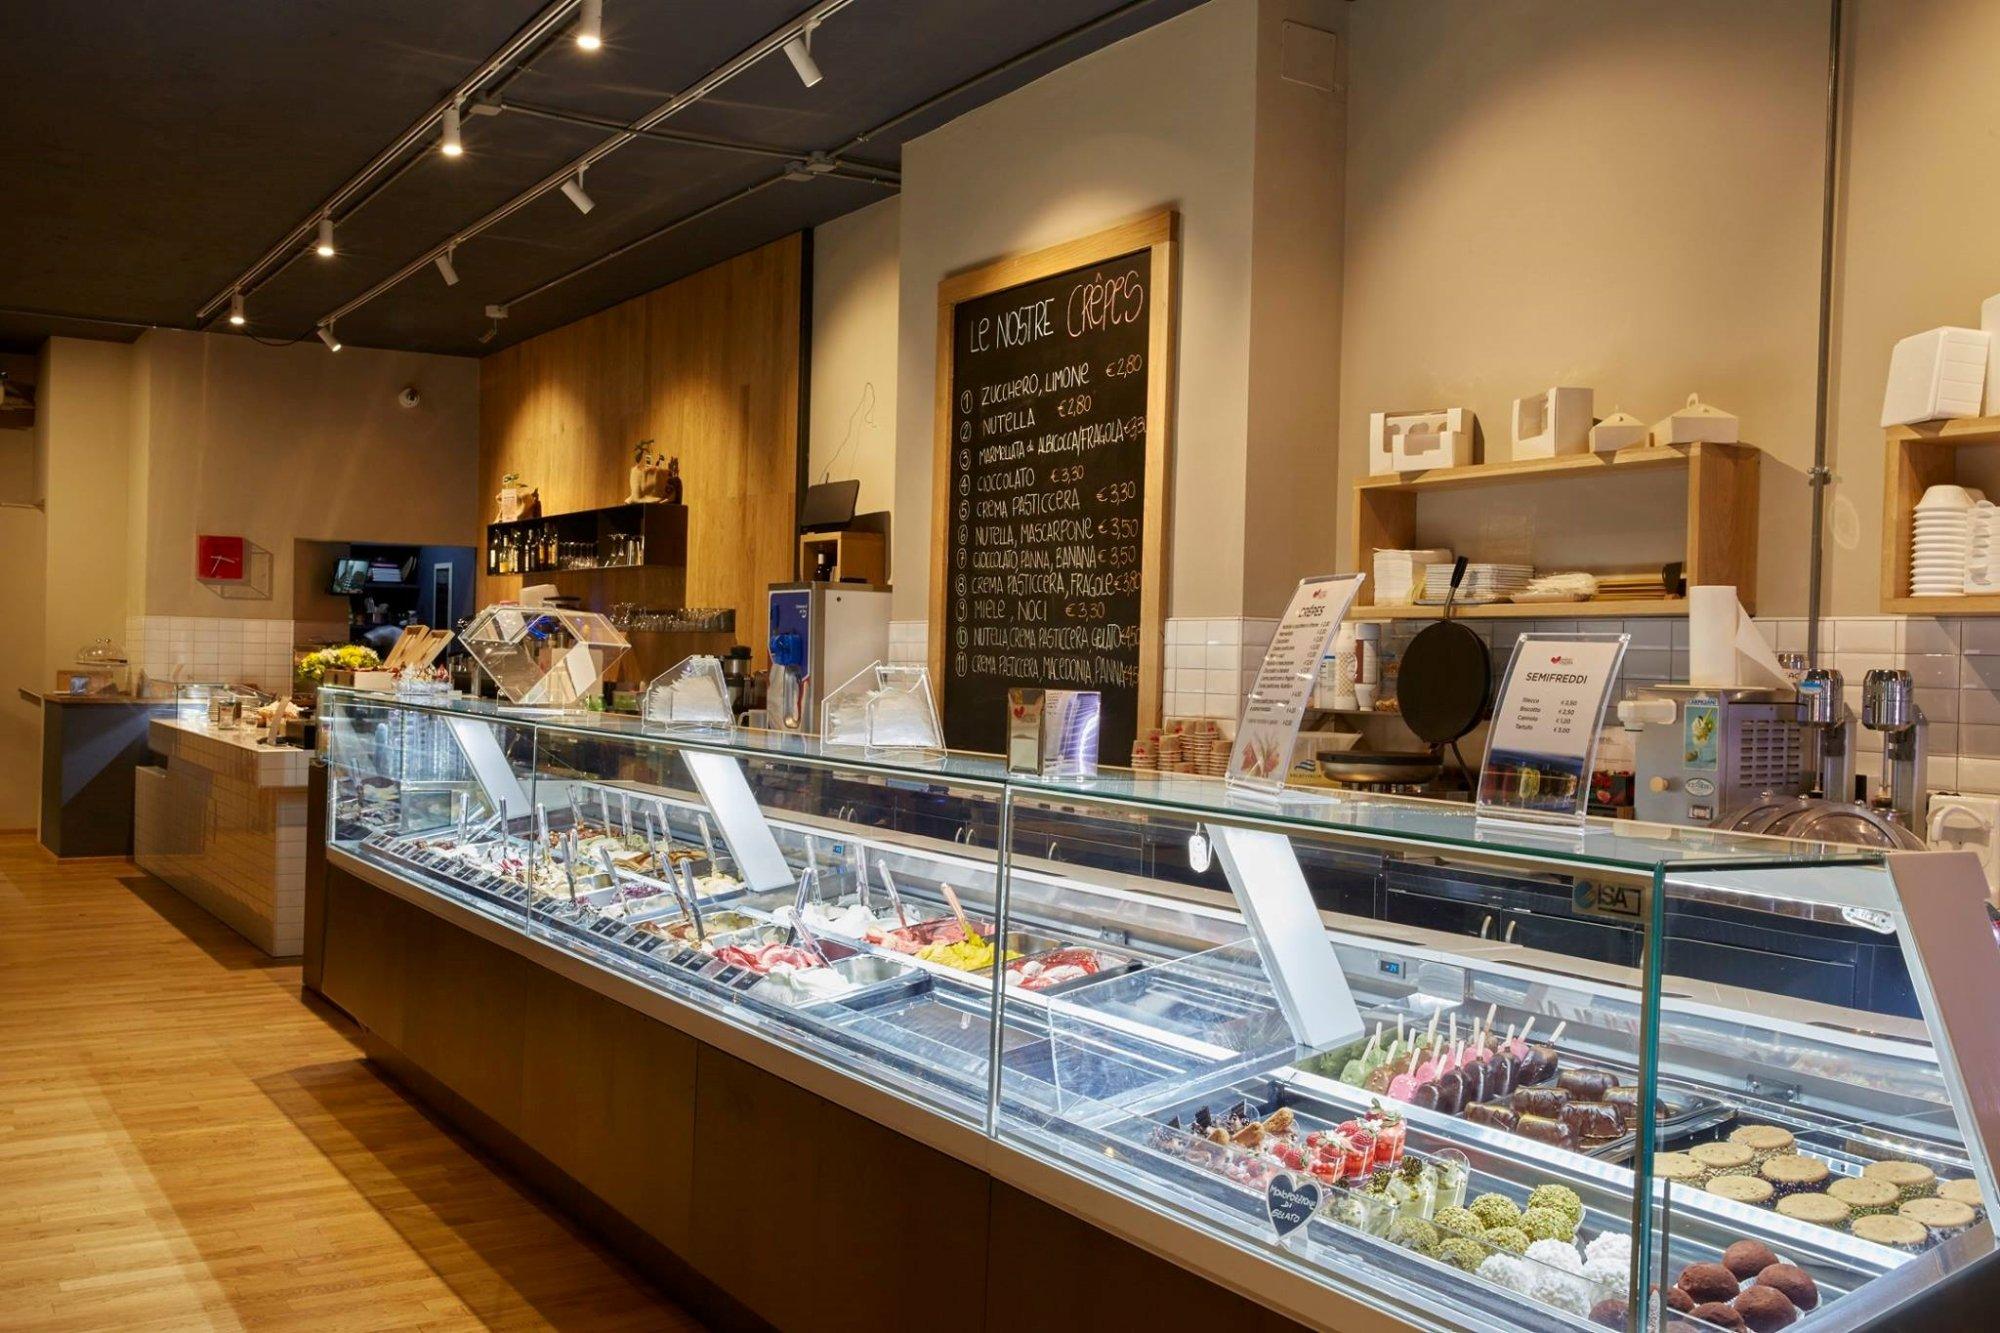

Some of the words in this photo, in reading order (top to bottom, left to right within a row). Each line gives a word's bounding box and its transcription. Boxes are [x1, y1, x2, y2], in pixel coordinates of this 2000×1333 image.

[997, 298, 1055, 348] NOSTRE
[1056, 546, 1097, 569] BANANA
[1018, 600, 1047, 621] NOCI
[1526, 672, 1587, 684] SEMIFREDDI
